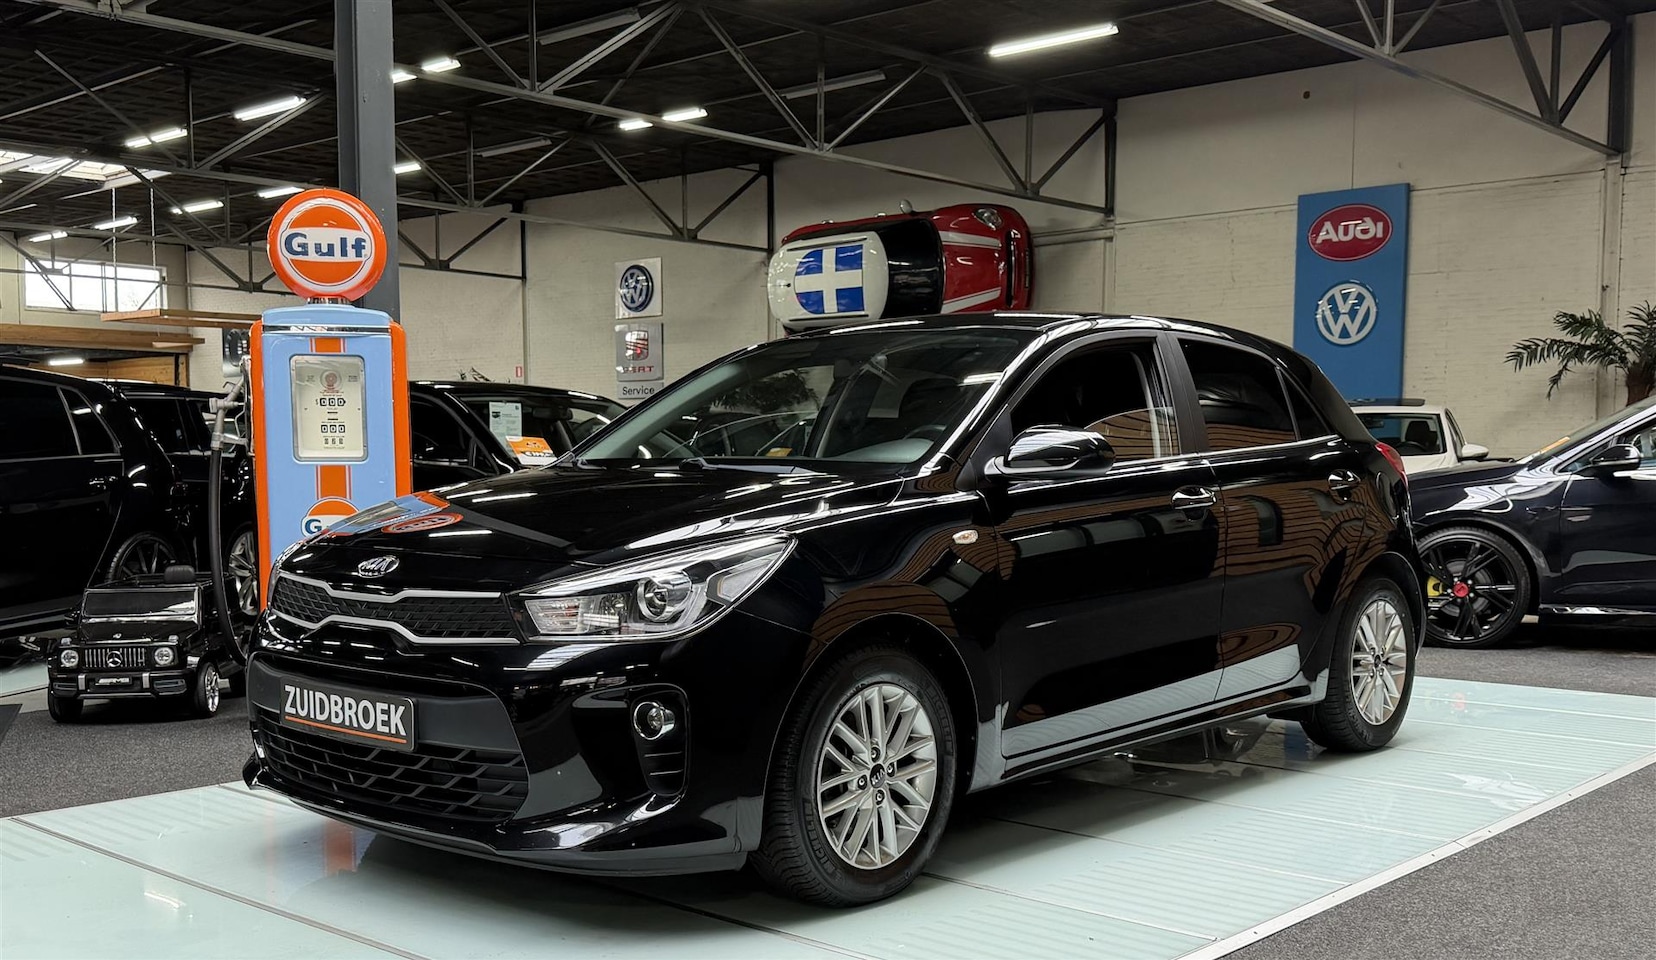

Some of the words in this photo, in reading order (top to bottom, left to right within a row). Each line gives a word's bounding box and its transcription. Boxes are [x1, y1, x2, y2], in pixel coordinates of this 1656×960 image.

[284, 232, 367, 258] Gulf
[1317, 283, 1377, 344] VW
[622, 385, 655, 396] Service
[284, 684, 407, 736] ZUIDBROEK
[871, 769, 886, 785] KIA
